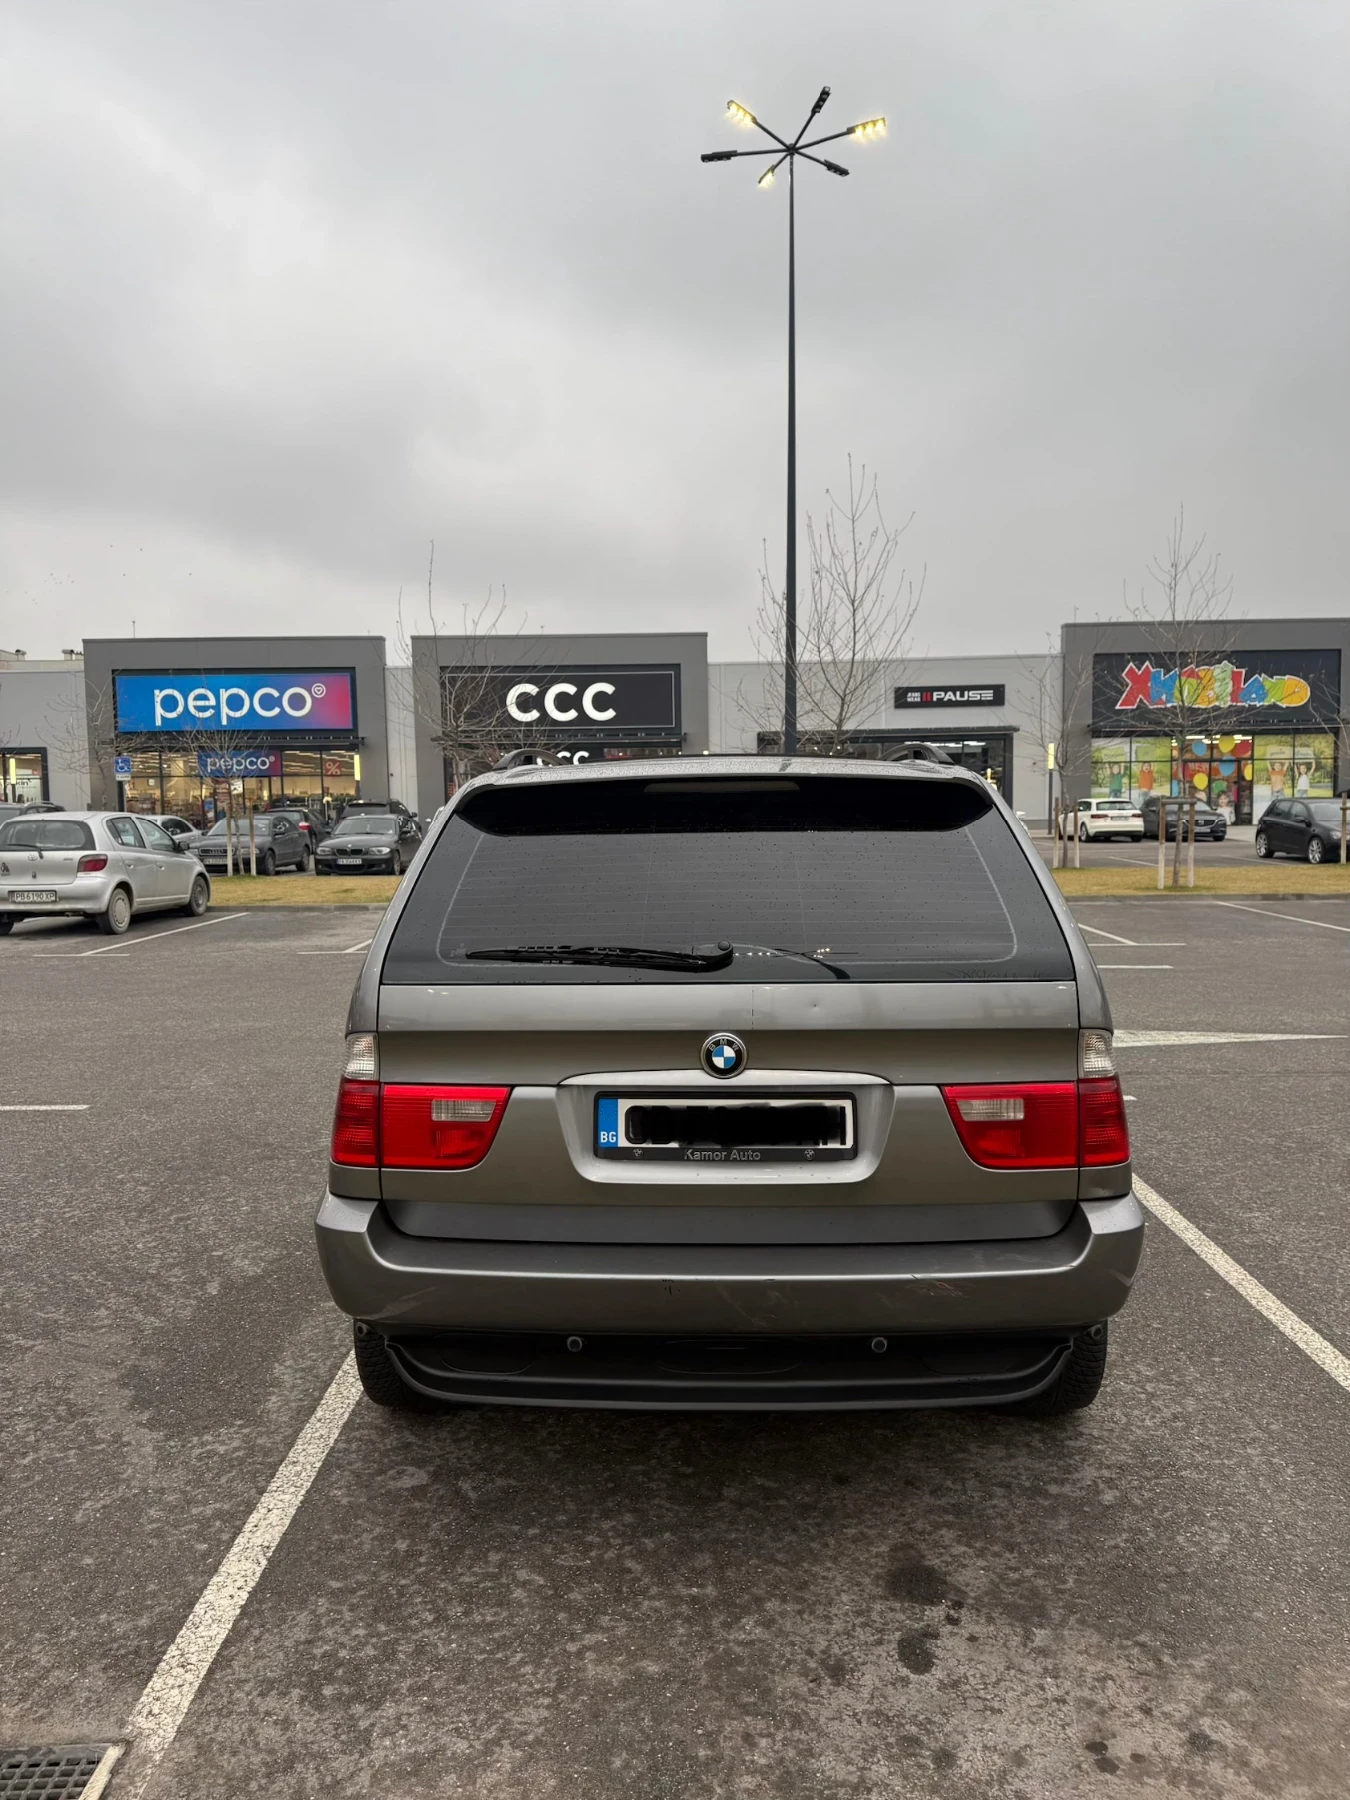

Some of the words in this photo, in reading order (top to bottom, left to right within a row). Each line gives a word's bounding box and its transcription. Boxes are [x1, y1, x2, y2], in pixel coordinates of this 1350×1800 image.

[506, 682, 616, 722] CCC
[933, 690, 993, 702] PAUSE
[154, 687, 312, 726] pepco
[207, 756, 270, 773] pepco
[708, 1038, 740, 1051] BMW
[600, 1131, 617, 1144] BG
[684, 1149, 727, 1161] Kamor
[730, 1149, 761, 1161] Auto
